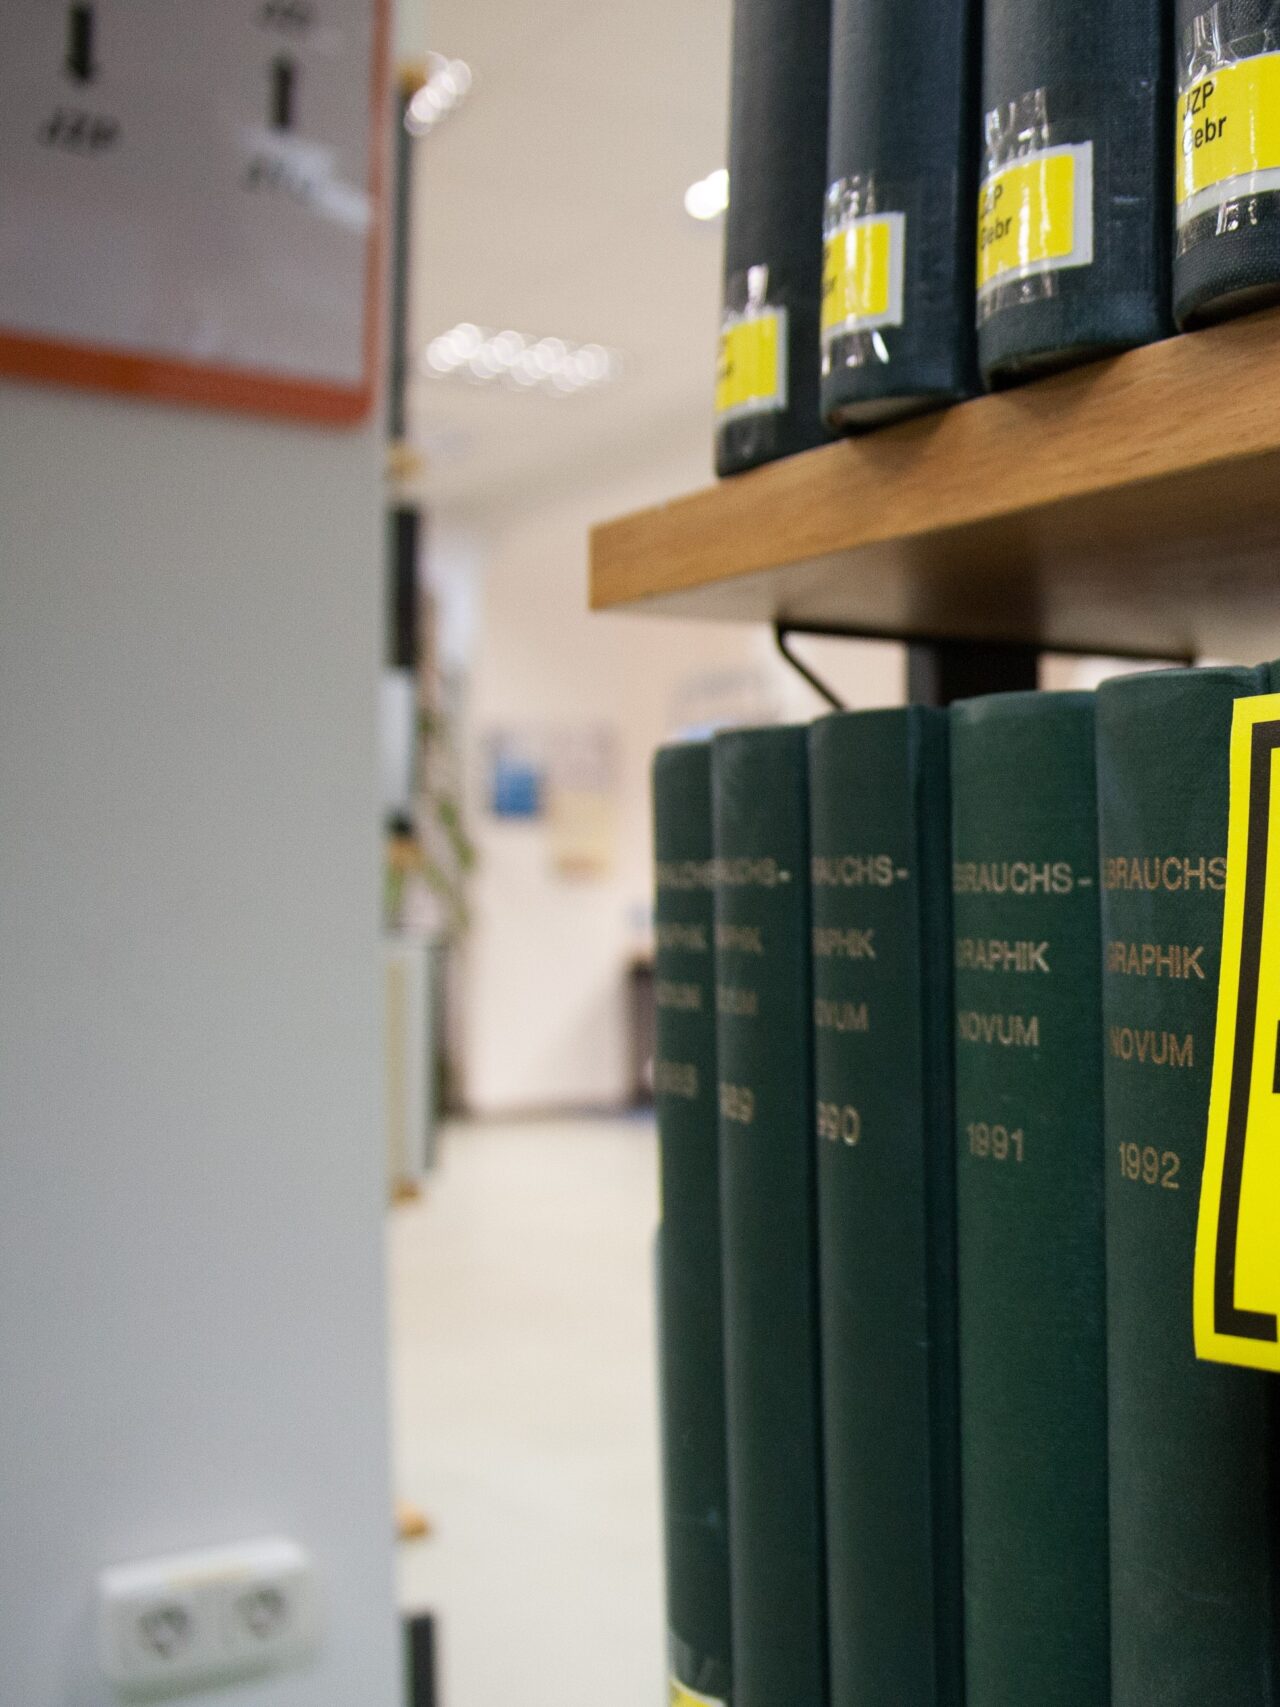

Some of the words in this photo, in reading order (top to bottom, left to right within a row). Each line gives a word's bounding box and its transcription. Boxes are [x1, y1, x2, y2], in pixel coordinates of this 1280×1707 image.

[1108, 1024, 1195, 1069] NOVUM
[966, 1120, 1026, 1164] 1991
[1118, 1141, 1183, 1191] 1992
